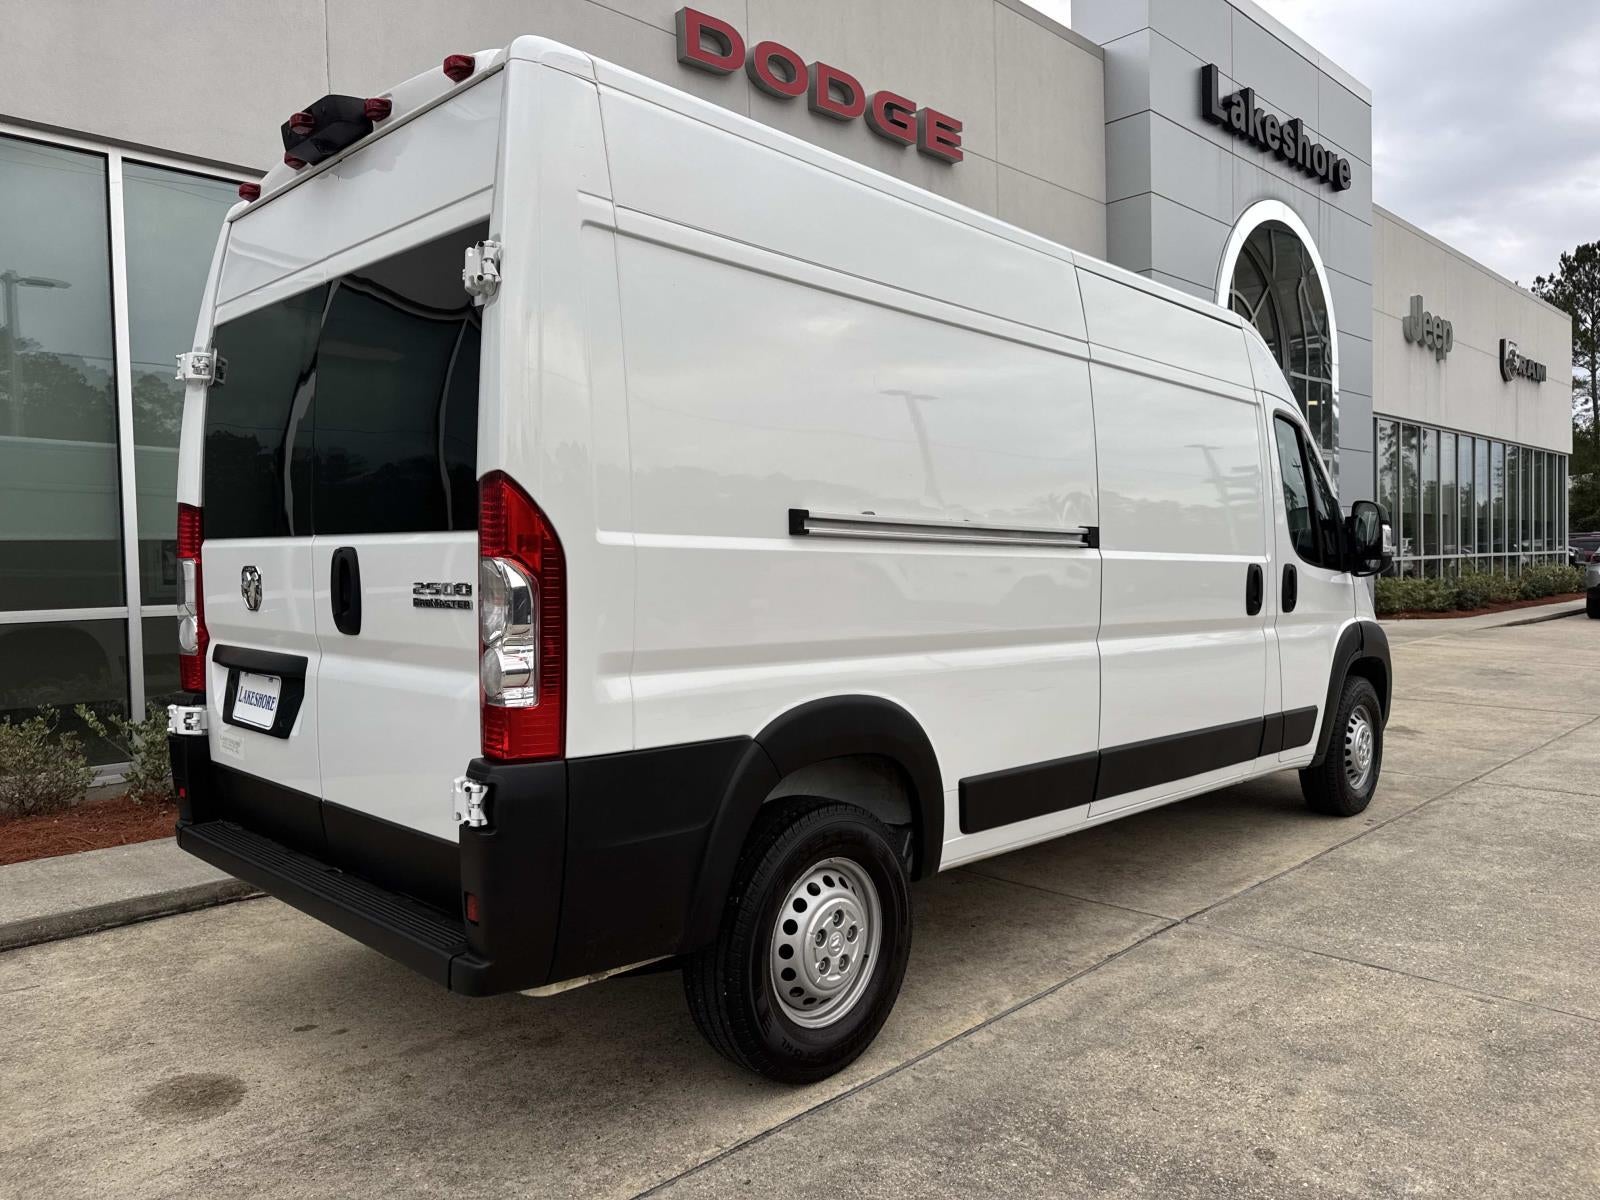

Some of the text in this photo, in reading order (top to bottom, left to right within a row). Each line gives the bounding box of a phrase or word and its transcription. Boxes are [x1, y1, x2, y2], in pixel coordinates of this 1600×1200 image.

[675, 6, 963, 164] DODGE
[1201, 63, 1351, 191] Lakeshore
[1402, 294, 1453, 361] Jeep
[1517, 354, 1546, 382] RAM
[413, 582, 472, 596] 2500
[238, 686, 276, 711] LAKESHORE
